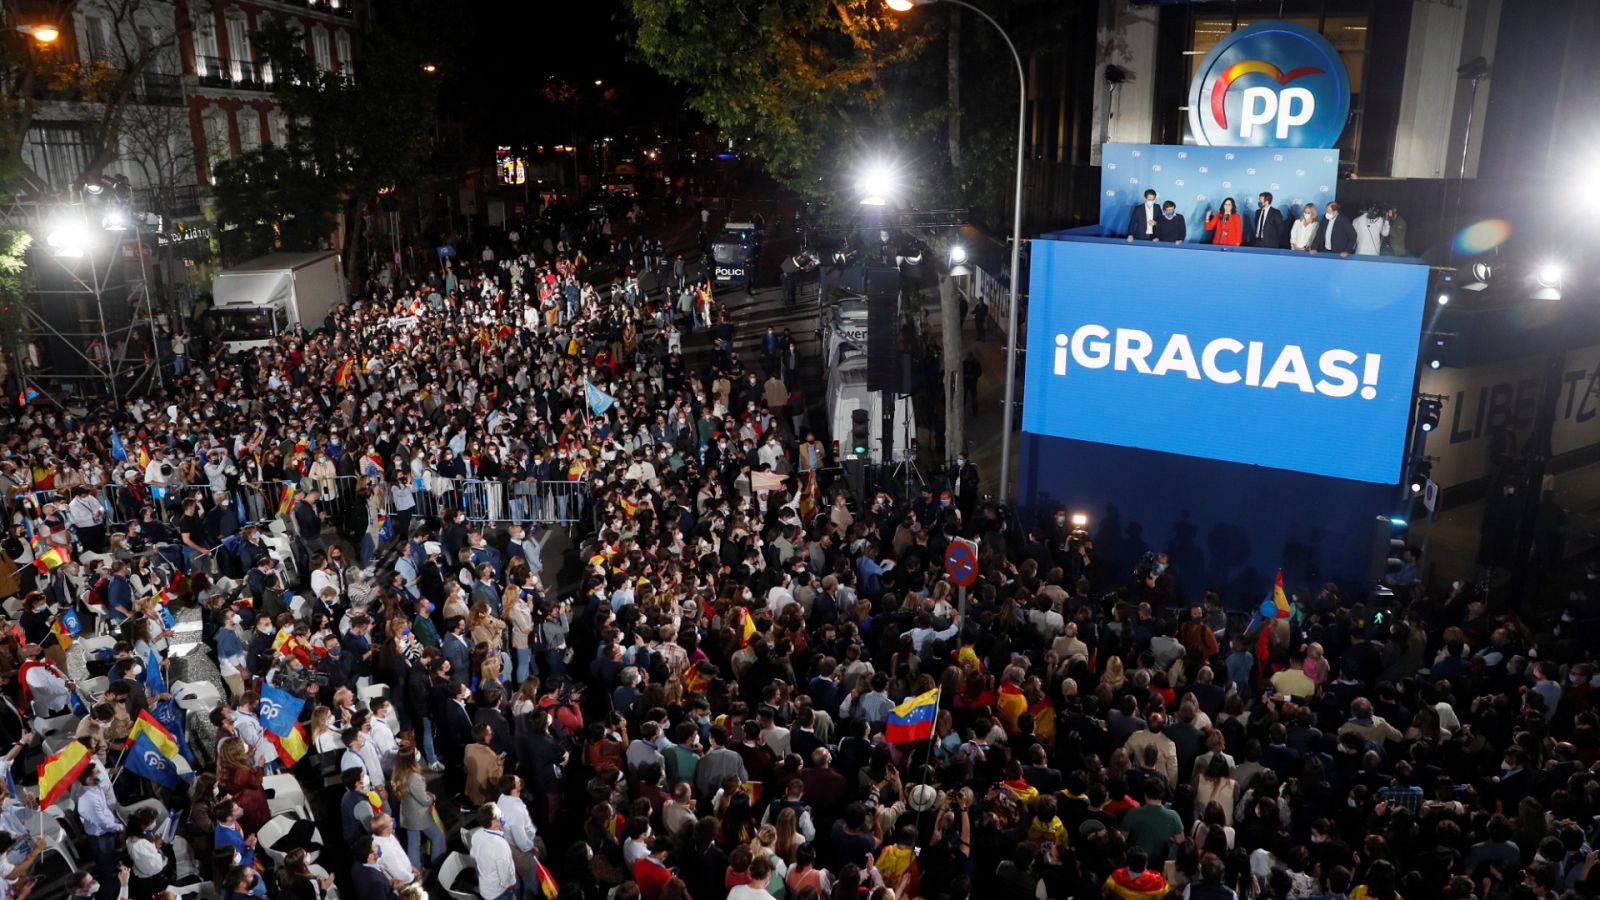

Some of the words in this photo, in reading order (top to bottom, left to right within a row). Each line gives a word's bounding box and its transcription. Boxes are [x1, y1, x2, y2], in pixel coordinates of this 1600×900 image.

[715, 268, 745, 276] POLICI
[1053, 323, 1382, 401] ¡GRACIAS!
[1450, 362, 1600, 444] LIBET
